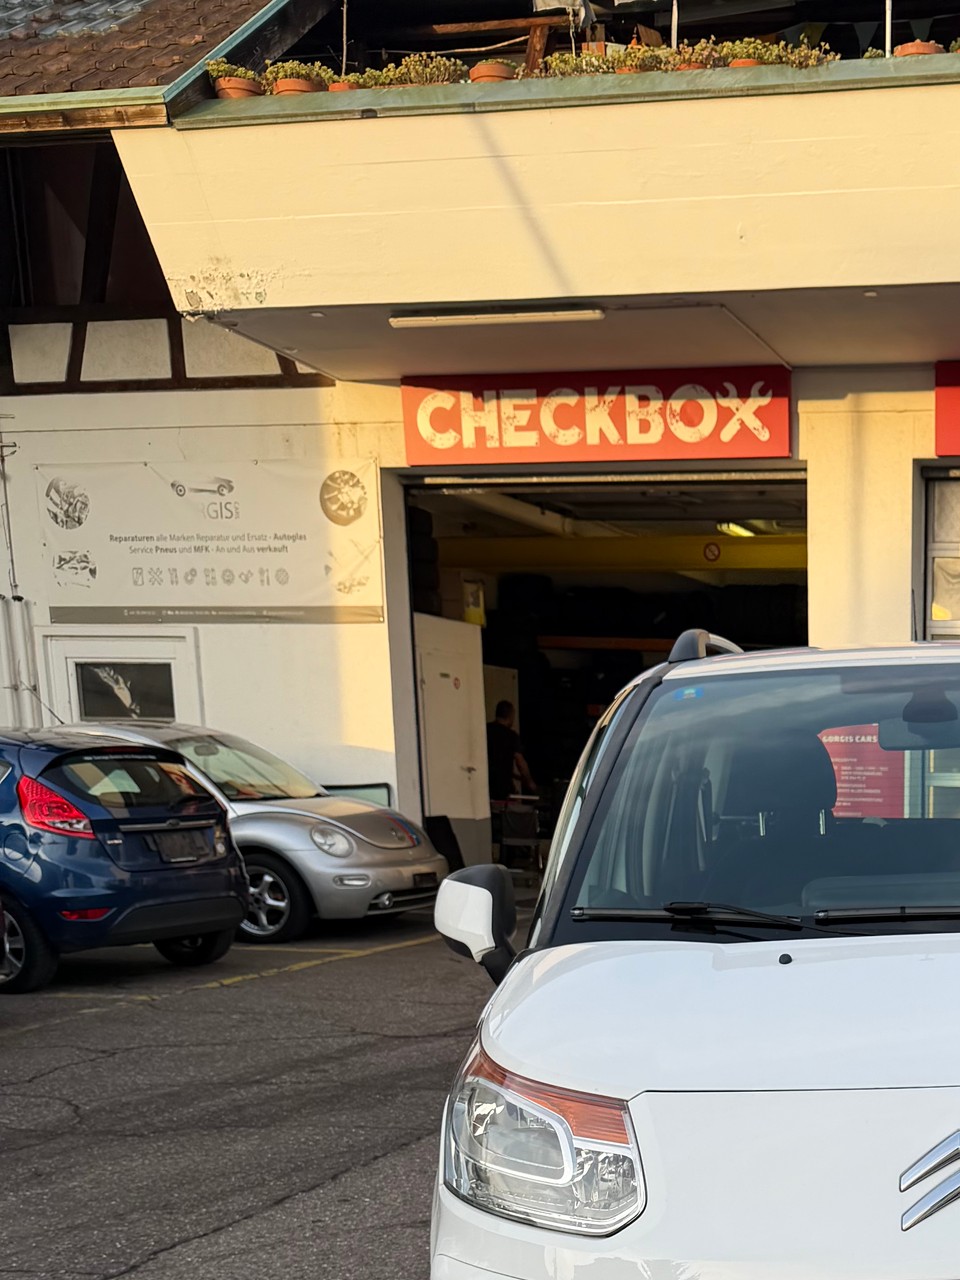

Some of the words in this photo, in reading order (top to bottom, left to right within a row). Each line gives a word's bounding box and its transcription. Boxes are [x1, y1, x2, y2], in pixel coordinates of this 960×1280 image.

[416, 380, 773, 449] CHECKBOX
[109, 534, 155, 543] Reparaturen
[155, 546, 177, 554] Pneus
[822, 735, 854, 743] GORGIS
[855, 735, 878, 743] CARS
